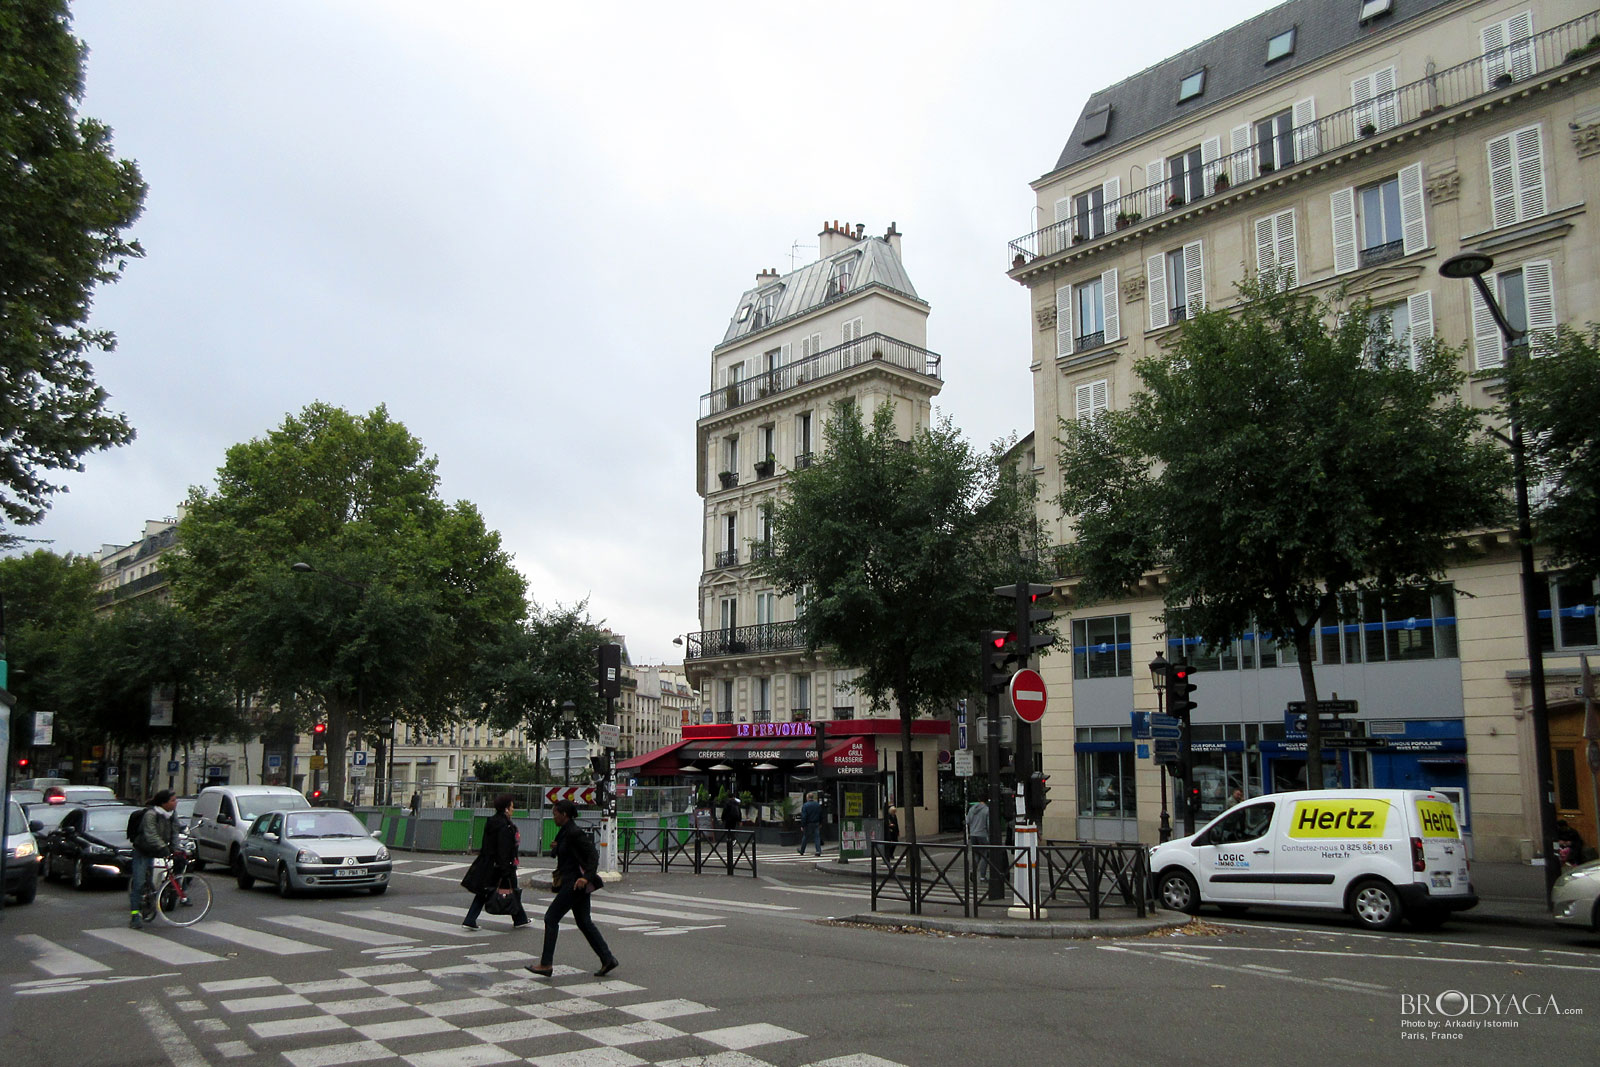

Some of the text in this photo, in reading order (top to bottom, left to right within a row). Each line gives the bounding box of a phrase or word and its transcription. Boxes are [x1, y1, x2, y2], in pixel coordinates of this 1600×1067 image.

[737, 722, 816, 736] LE PREVOYAN
[356, 753, 364, 764] P
[748, 750, 780, 758] BRASSERIE
[1298, 808, 1374, 829] Hertz
[1421, 809, 1455, 832] Hertz
